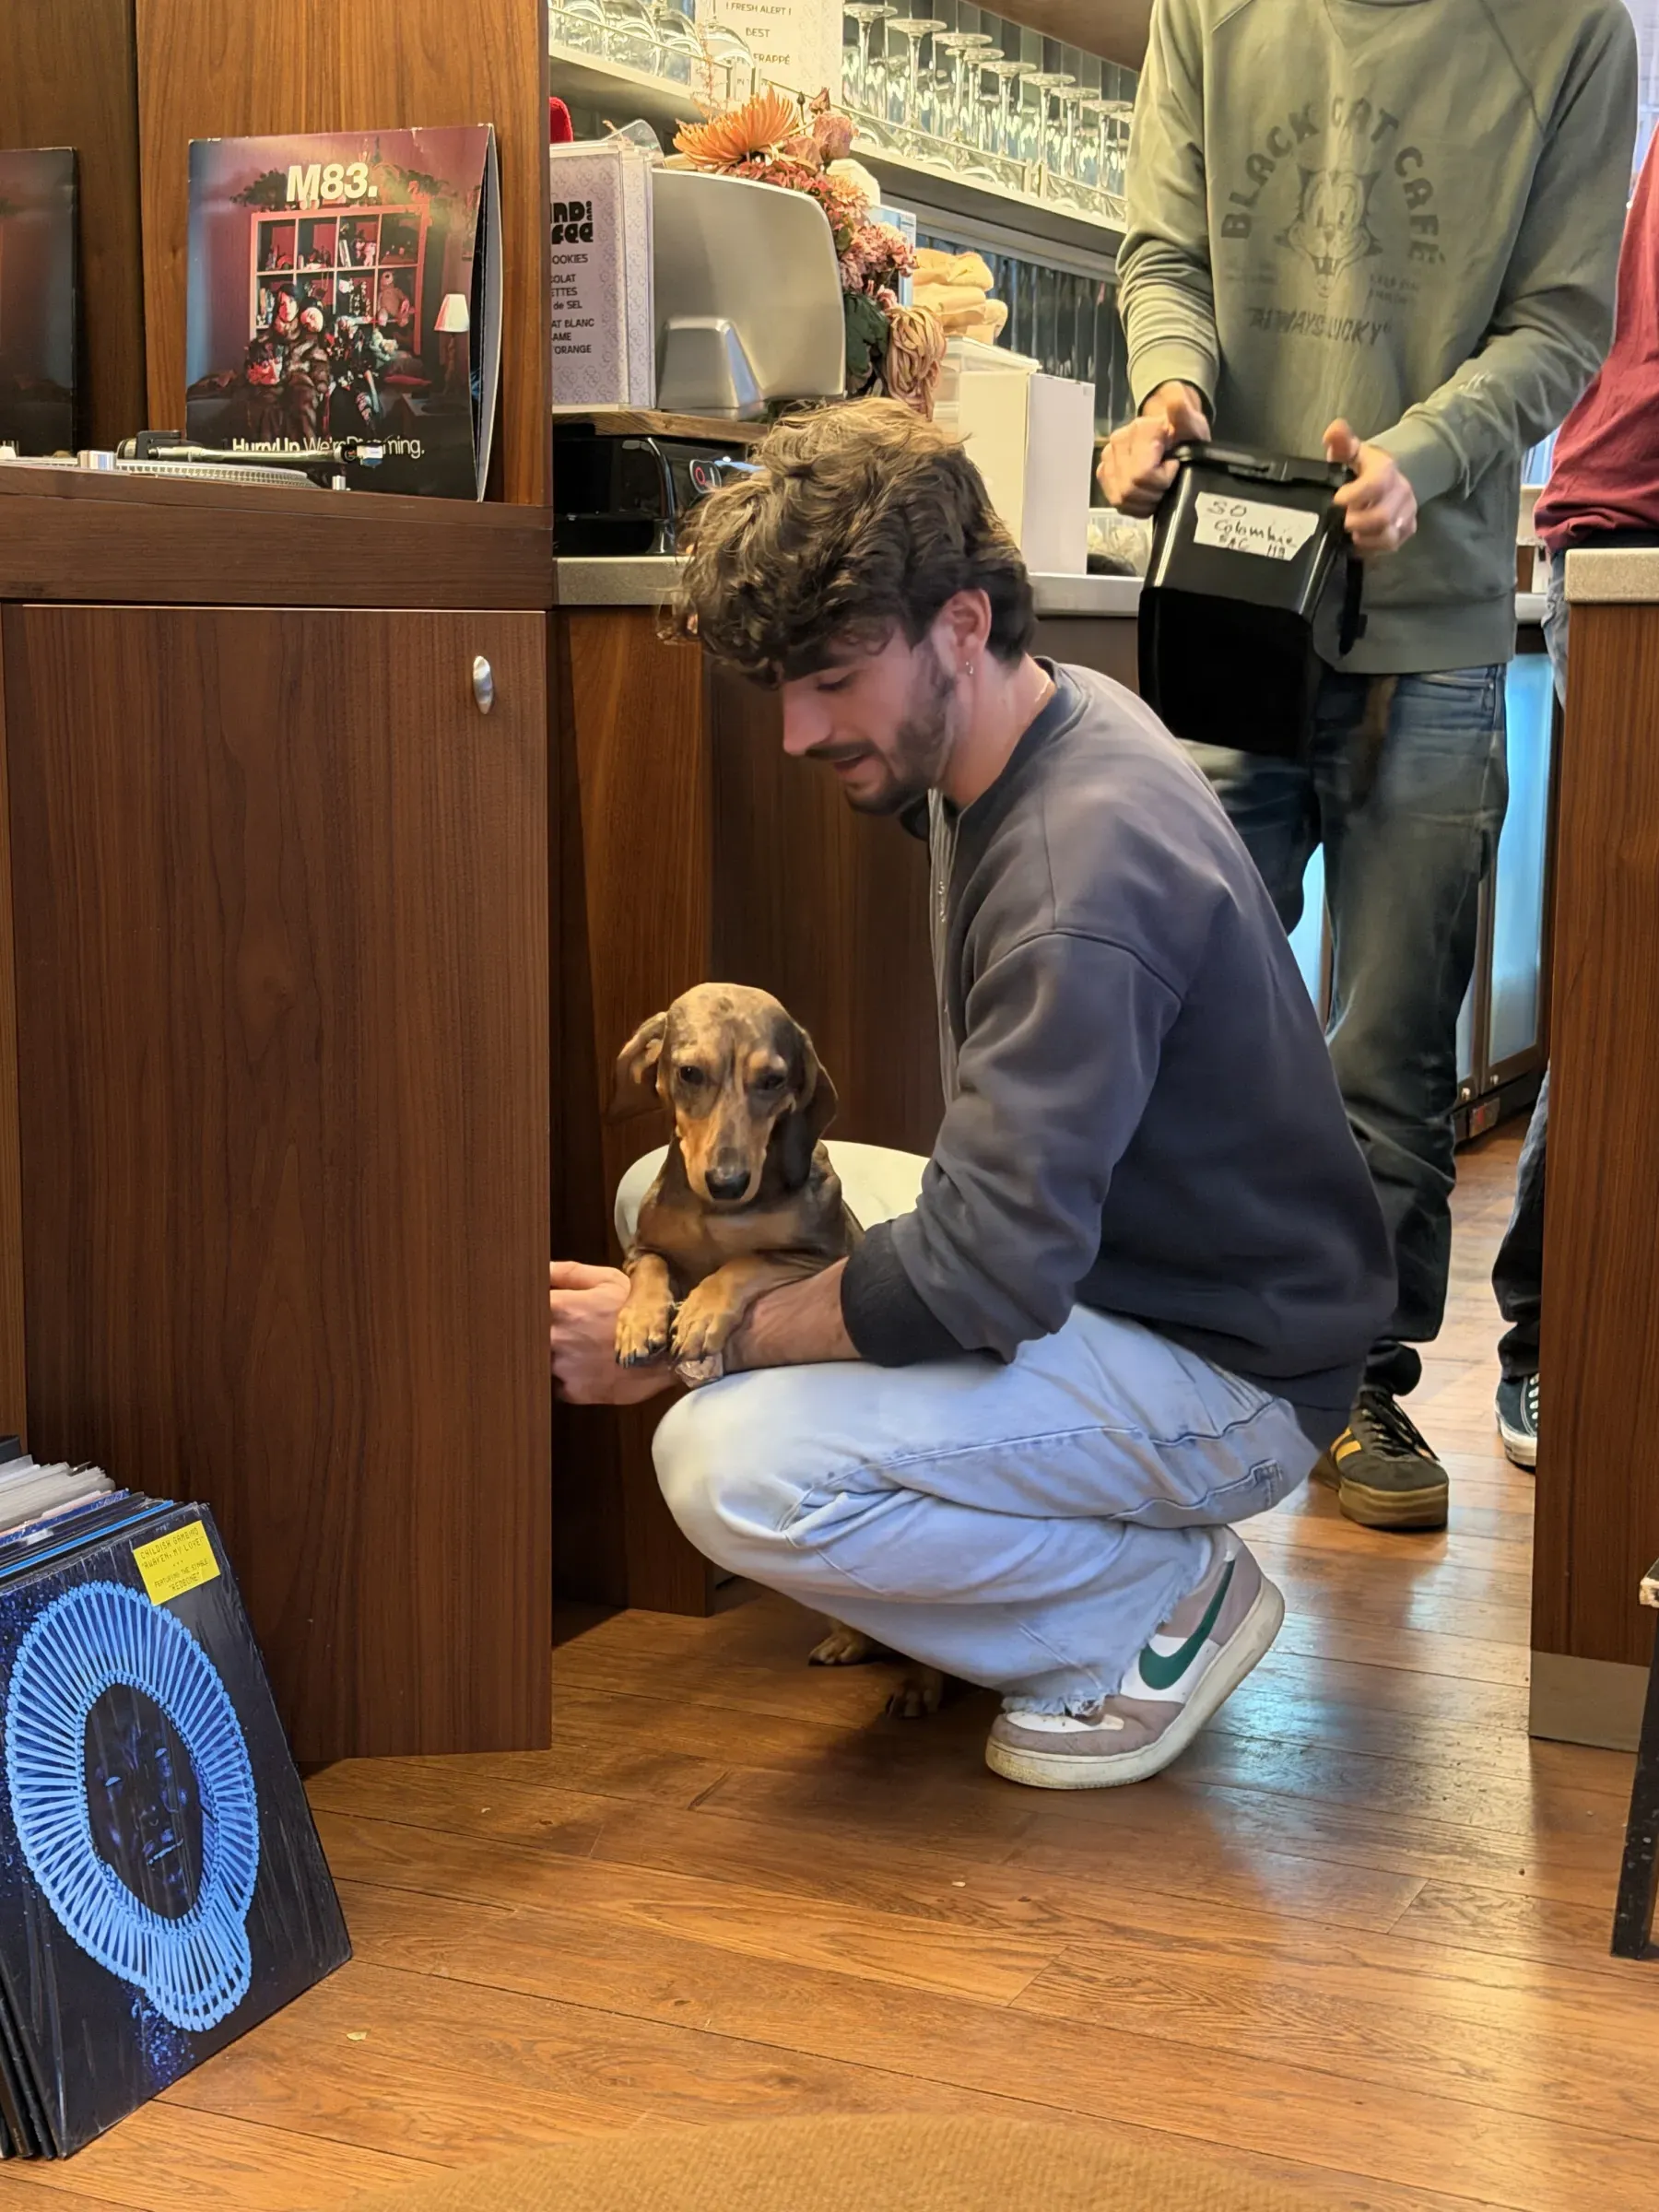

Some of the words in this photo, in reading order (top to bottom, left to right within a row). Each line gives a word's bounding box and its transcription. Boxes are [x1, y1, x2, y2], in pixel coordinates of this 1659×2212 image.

[731, 3, 759, 13] FRESH
[759, 5, 787, 16] ALERT
[745, 27, 771, 38] BEST
[1221, 101, 1320, 239] BLACK
[1332, 96, 1399, 143] CAT
[287, 162, 378, 202] M83.
[552, 253, 589, 265] OOKIES
[566, 300, 582, 310] SEL
[551, 320, 561, 328] AT
[564, 318, 594, 328] BLANC
[552, 333, 571, 341] AME
[140, 1540, 172, 1559] CHILDISH
[173, 1545, 183, 1557] MY
